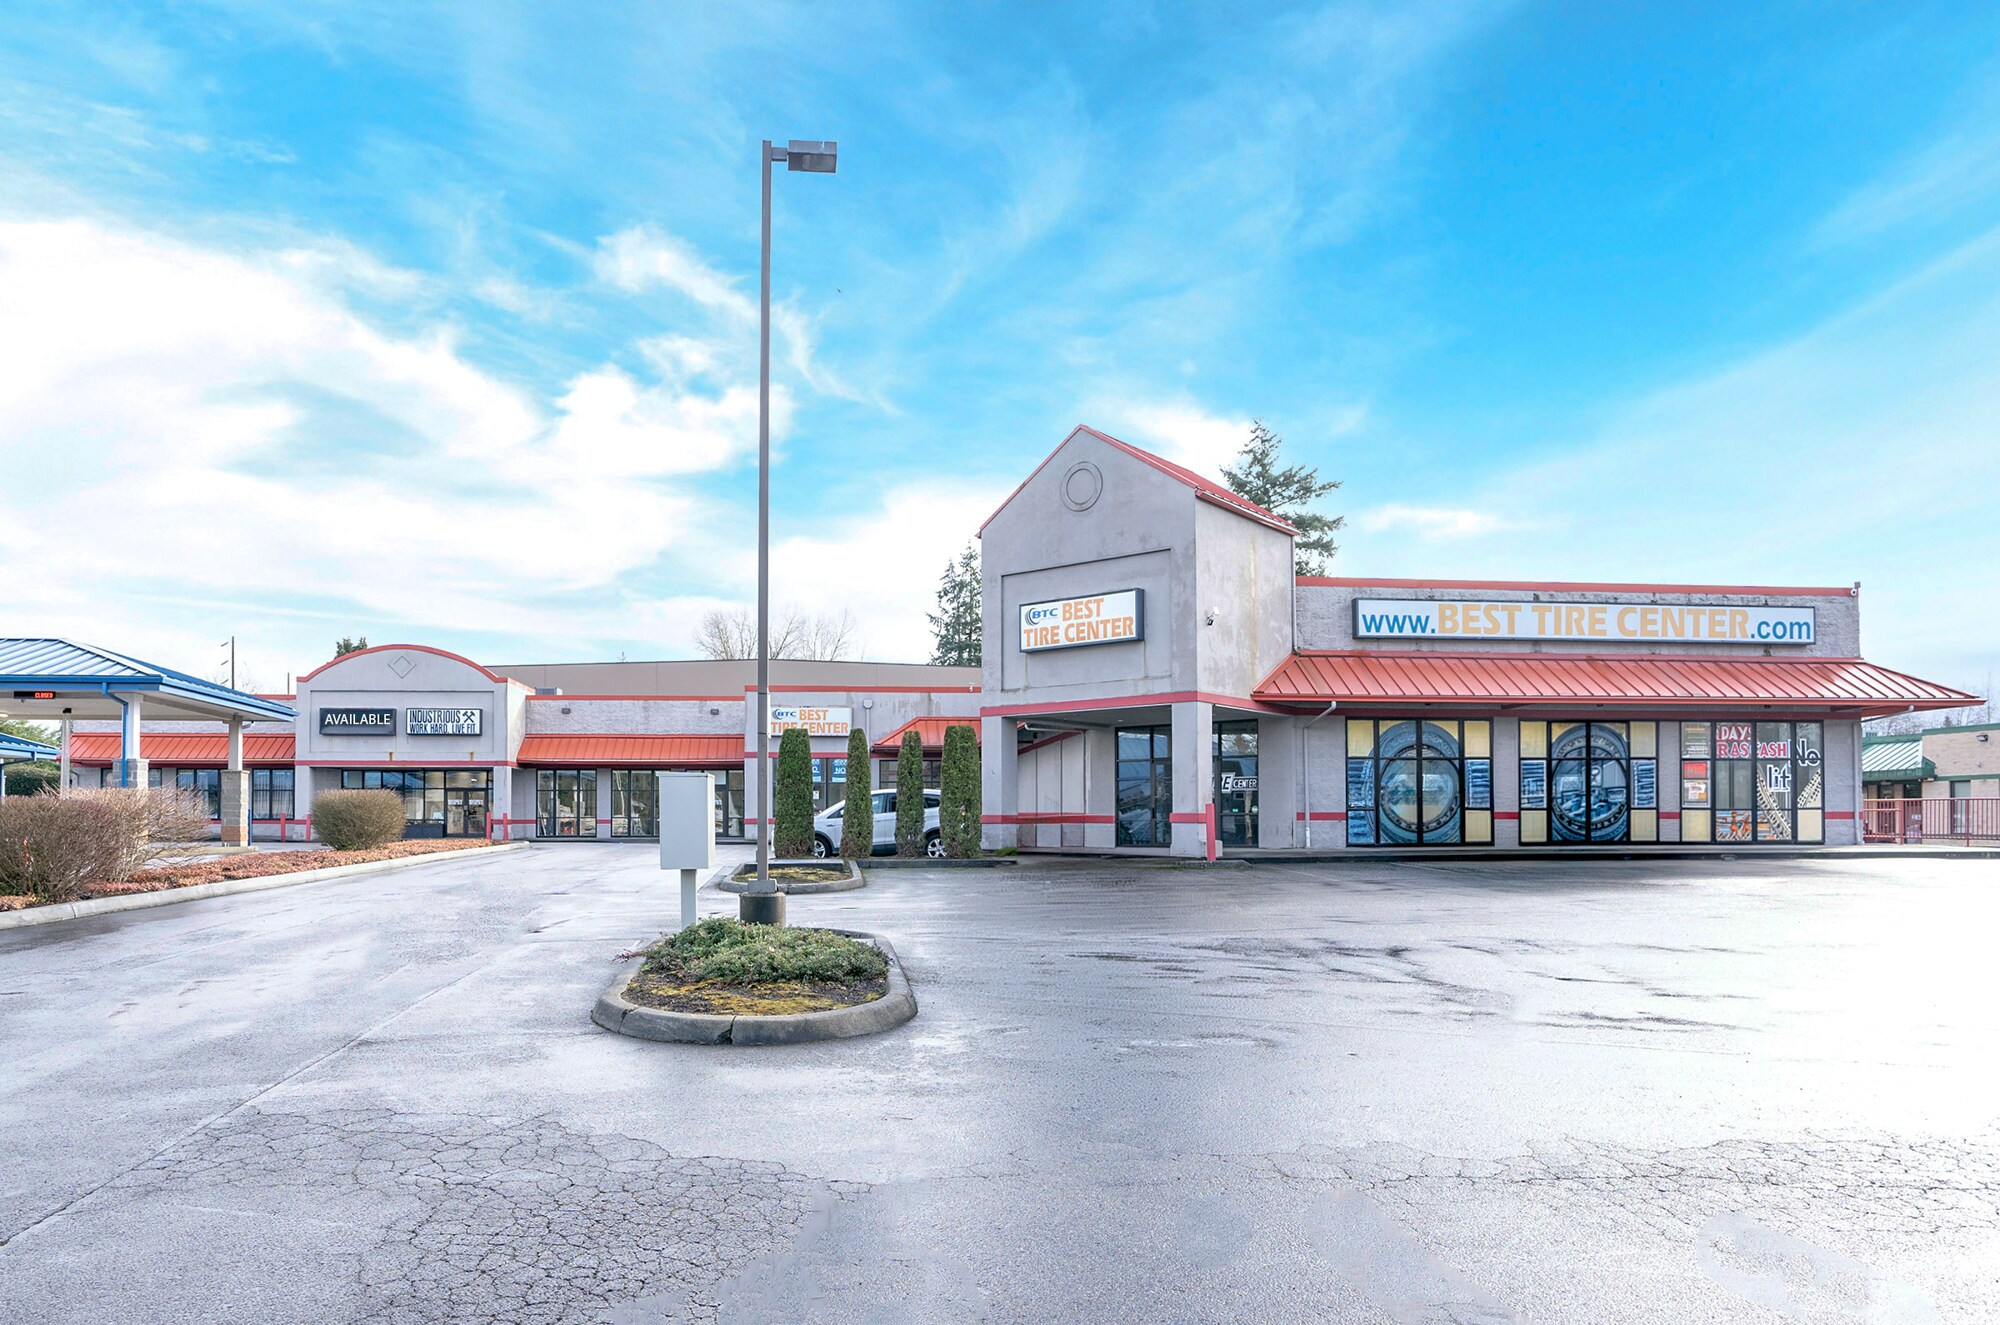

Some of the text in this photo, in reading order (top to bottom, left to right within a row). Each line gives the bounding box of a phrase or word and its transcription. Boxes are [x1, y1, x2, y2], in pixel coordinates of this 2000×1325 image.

[1032, 598, 1104, 621] BTC BEST
[1531, 606, 1607, 636] TIRE
[1024, 617, 1134, 647] TIRE CENTER
[324, 713, 391, 725] AVAILABLE
[409, 710, 461, 723] INDUSTRIOUS
[799, 709, 828, 721] BEST
[409, 723, 428, 733] WORK
[452, 723, 465, 733] LIVE
[800, 722, 848, 734] CENTER
[1233, 779, 1257, 788] CENTER
